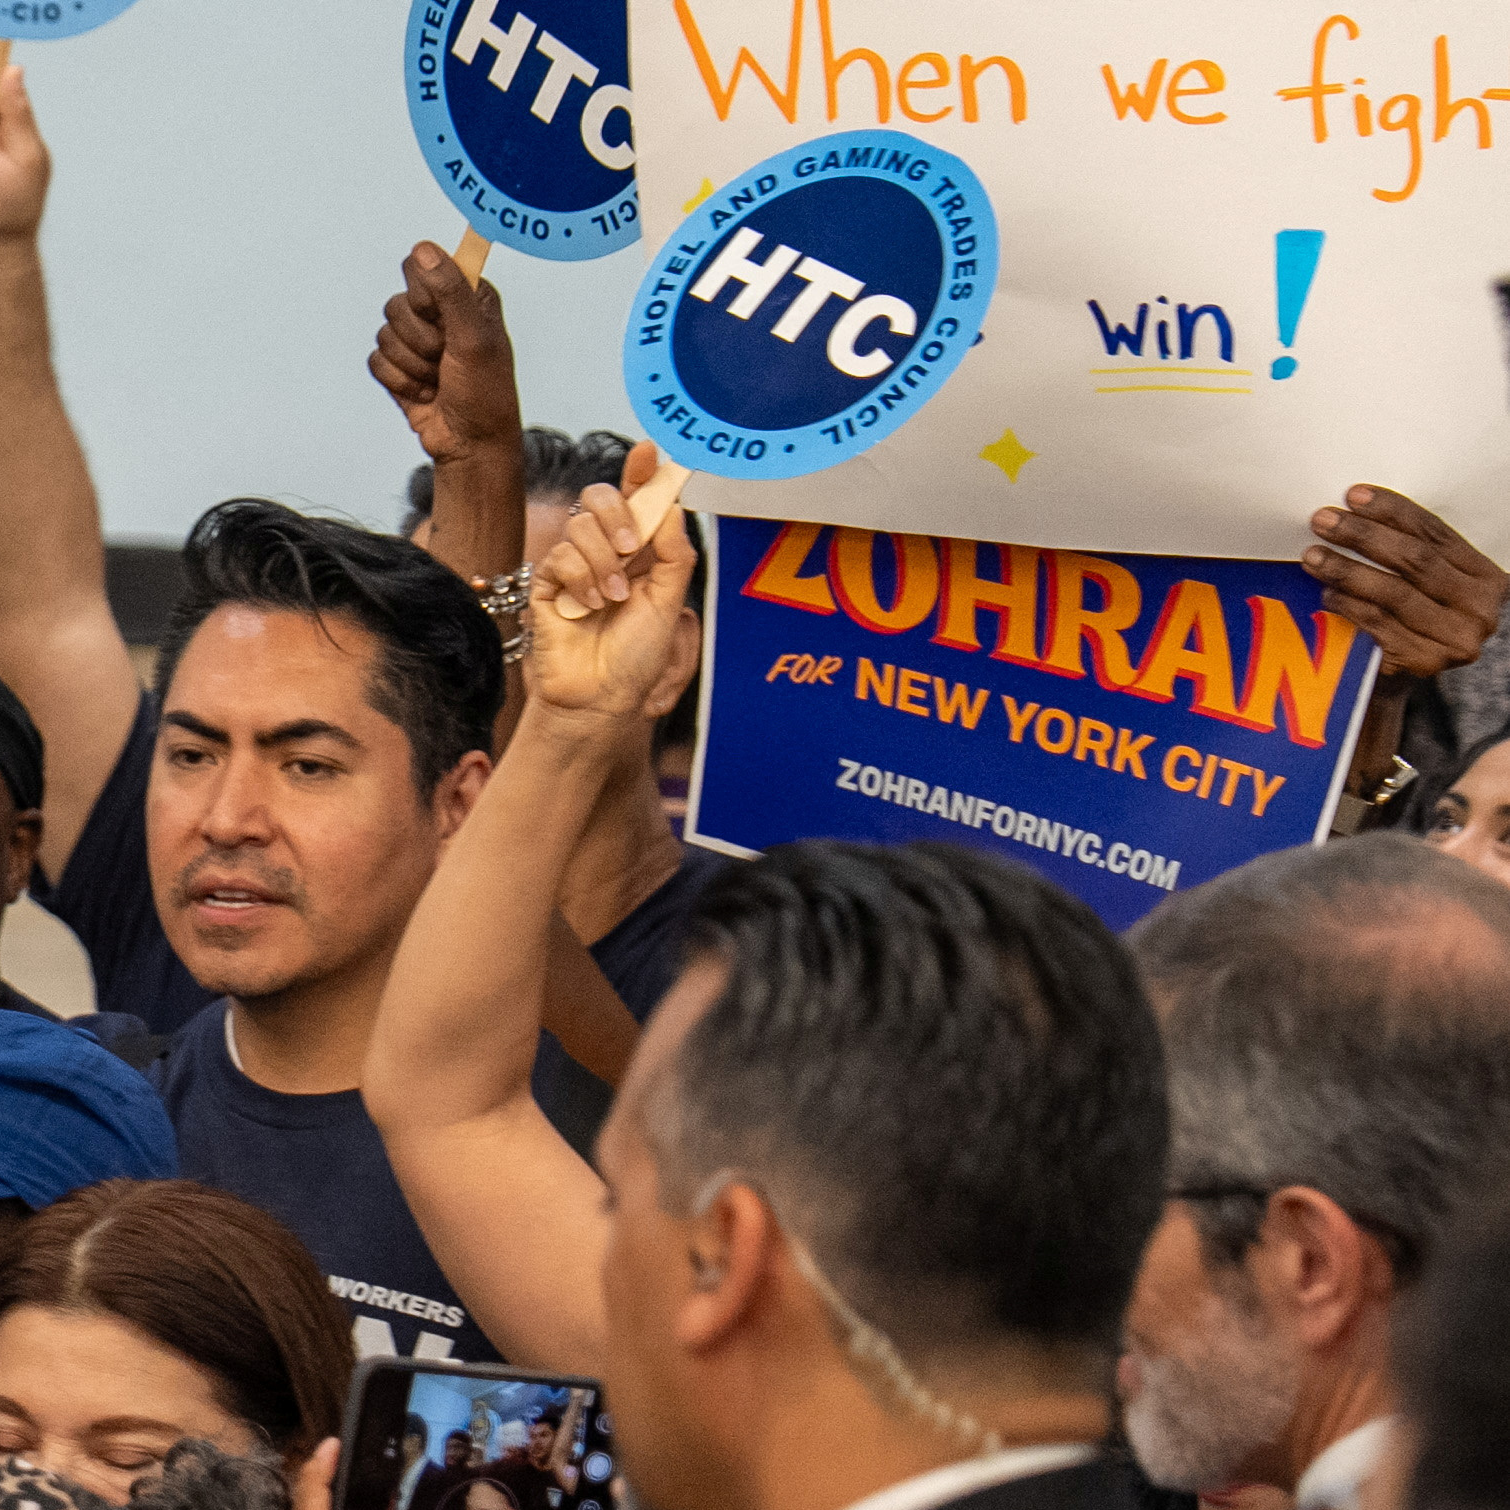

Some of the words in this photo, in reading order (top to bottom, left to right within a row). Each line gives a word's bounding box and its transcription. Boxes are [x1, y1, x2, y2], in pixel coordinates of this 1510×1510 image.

[452, 0, 636, 171] HTC
[673, 0, 1027, 125] When
[1101, 57, 1228, 126] we
[444, 158, 550, 240] AFL-CIO
[708, 173, 779, 231] AND
[792, 147, 931, 181] GAMING
[639, 240, 706, 345] HOTEL
[929, 176, 977, 301] TRADES
[688, 226, 918, 378] HTC
[651, 393, 767, 461] AFL-CIO
[820, 316, 959, 445] COUNCIL
[741, 521, 1358, 749] ZOHRAN
[766, 652, 843, 686] FOR
[855, 656, 990, 730] NEW
[1001, 694, 1157, 780] YORK
[1161, 745, 1286, 817] CITY
[836, 757, 1181, 890] ZOHRANFORNYC.COM
[329, 1274, 466, 1328] WORKERS
